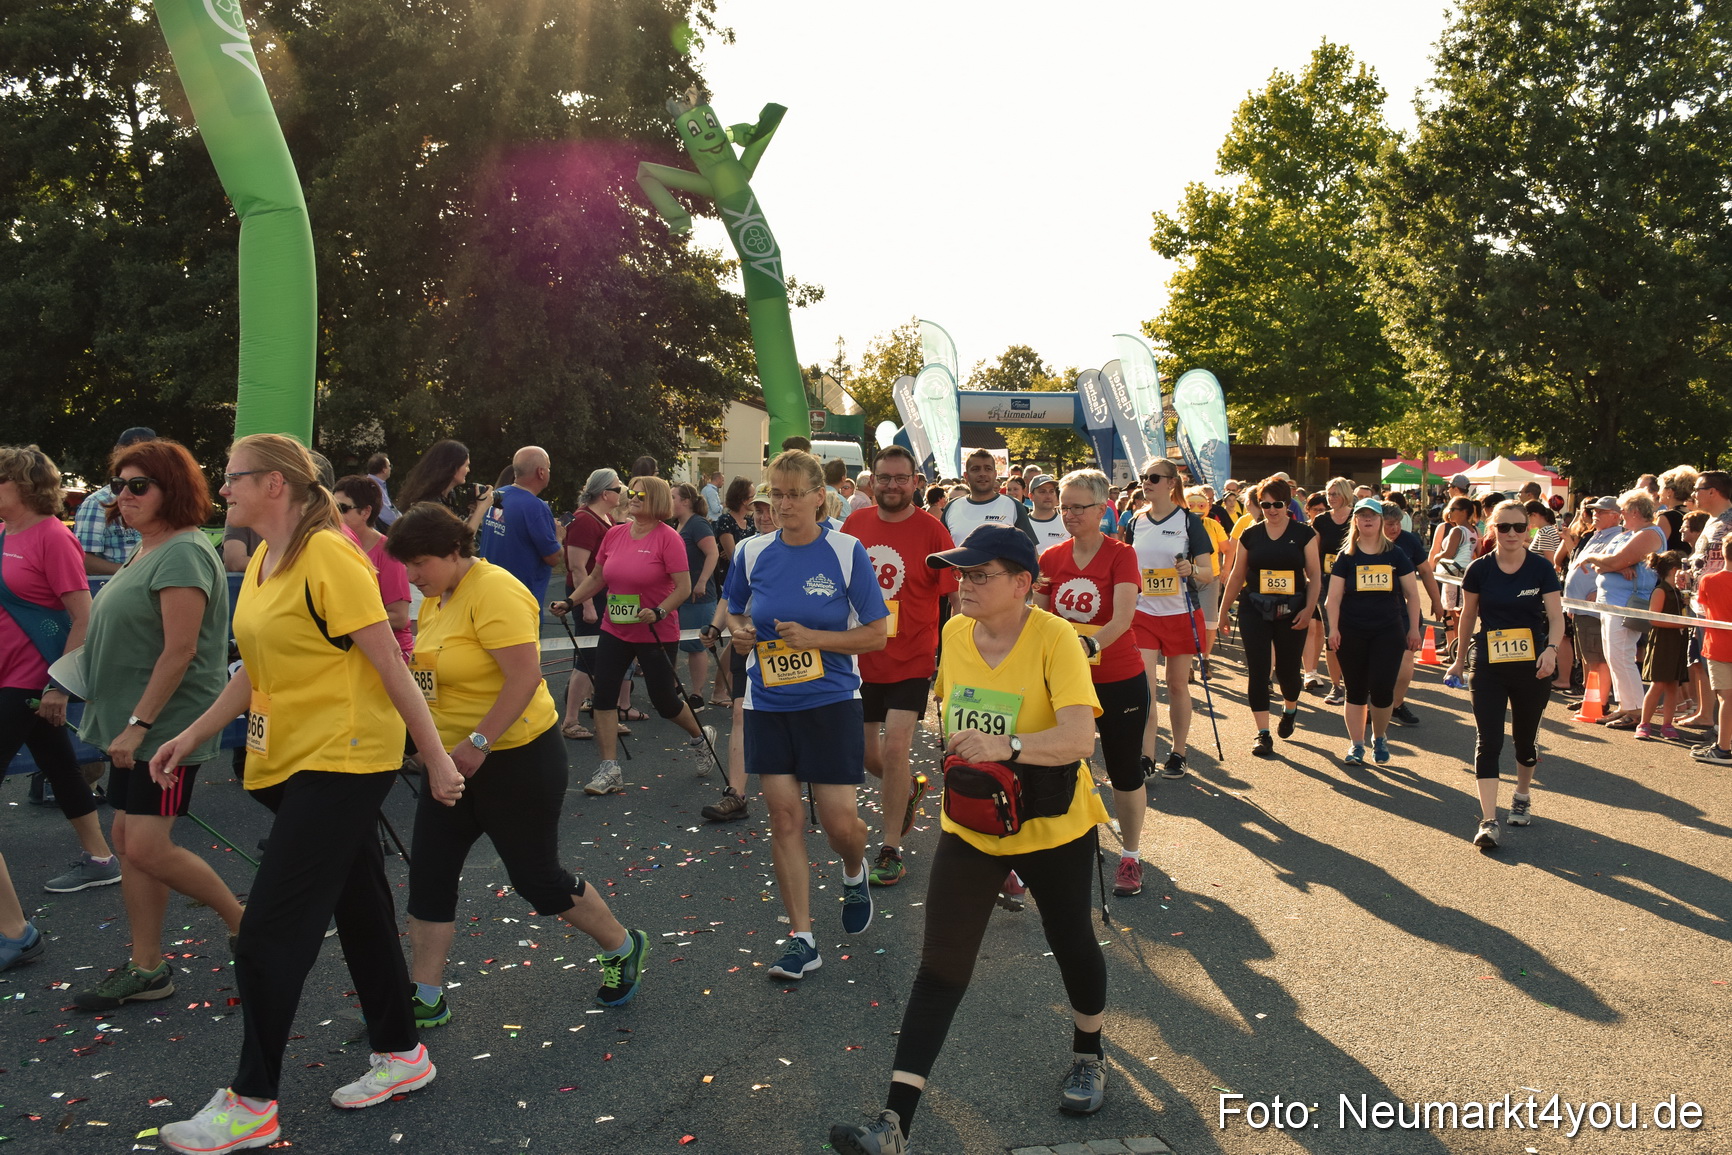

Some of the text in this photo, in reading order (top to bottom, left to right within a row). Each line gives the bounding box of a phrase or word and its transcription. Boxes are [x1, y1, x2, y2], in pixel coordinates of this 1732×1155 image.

[722, 194, 786, 289] AOK
[1003, 410, 1047, 419] firmenlauf
[485, 519, 506, 533] camping
[1147, 578, 1174, 588] 1917
[1267, 578, 1287, 587] 853
[1361, 574, 1388, 583] 1113
[1059, 588, 1094, 613] 48
[610, 604, 635, 615] 2067
[1493, 639, 1528, 653] 1116
[767, 651, 812, 673] 1960
[412, 671, 433, 690] 685
[954, 708, 1006, 735] 1639
